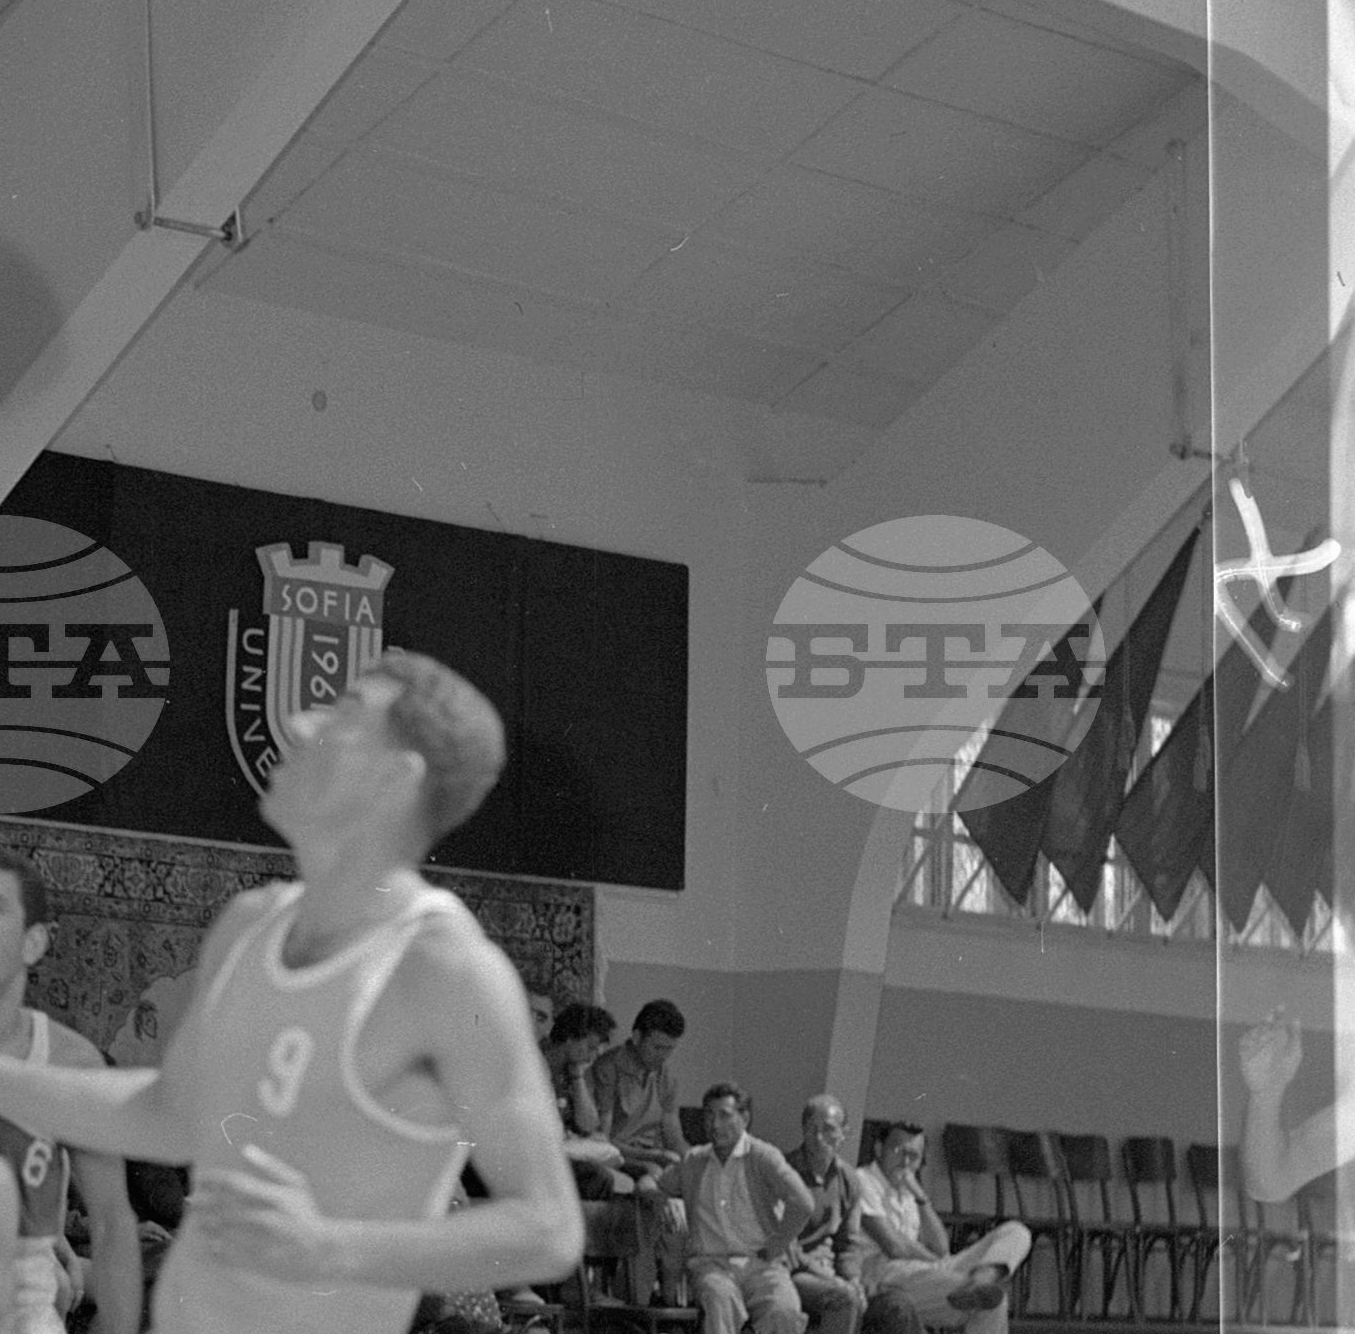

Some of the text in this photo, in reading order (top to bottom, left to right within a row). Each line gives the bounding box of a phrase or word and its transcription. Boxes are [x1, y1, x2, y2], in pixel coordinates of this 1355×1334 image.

[281, 584, 376, 625] SOFIA
[310, 634, 339, 711] 1961
[257, 1027, 313, 1117] 9
[22, 1140, 52, 1187] 6
